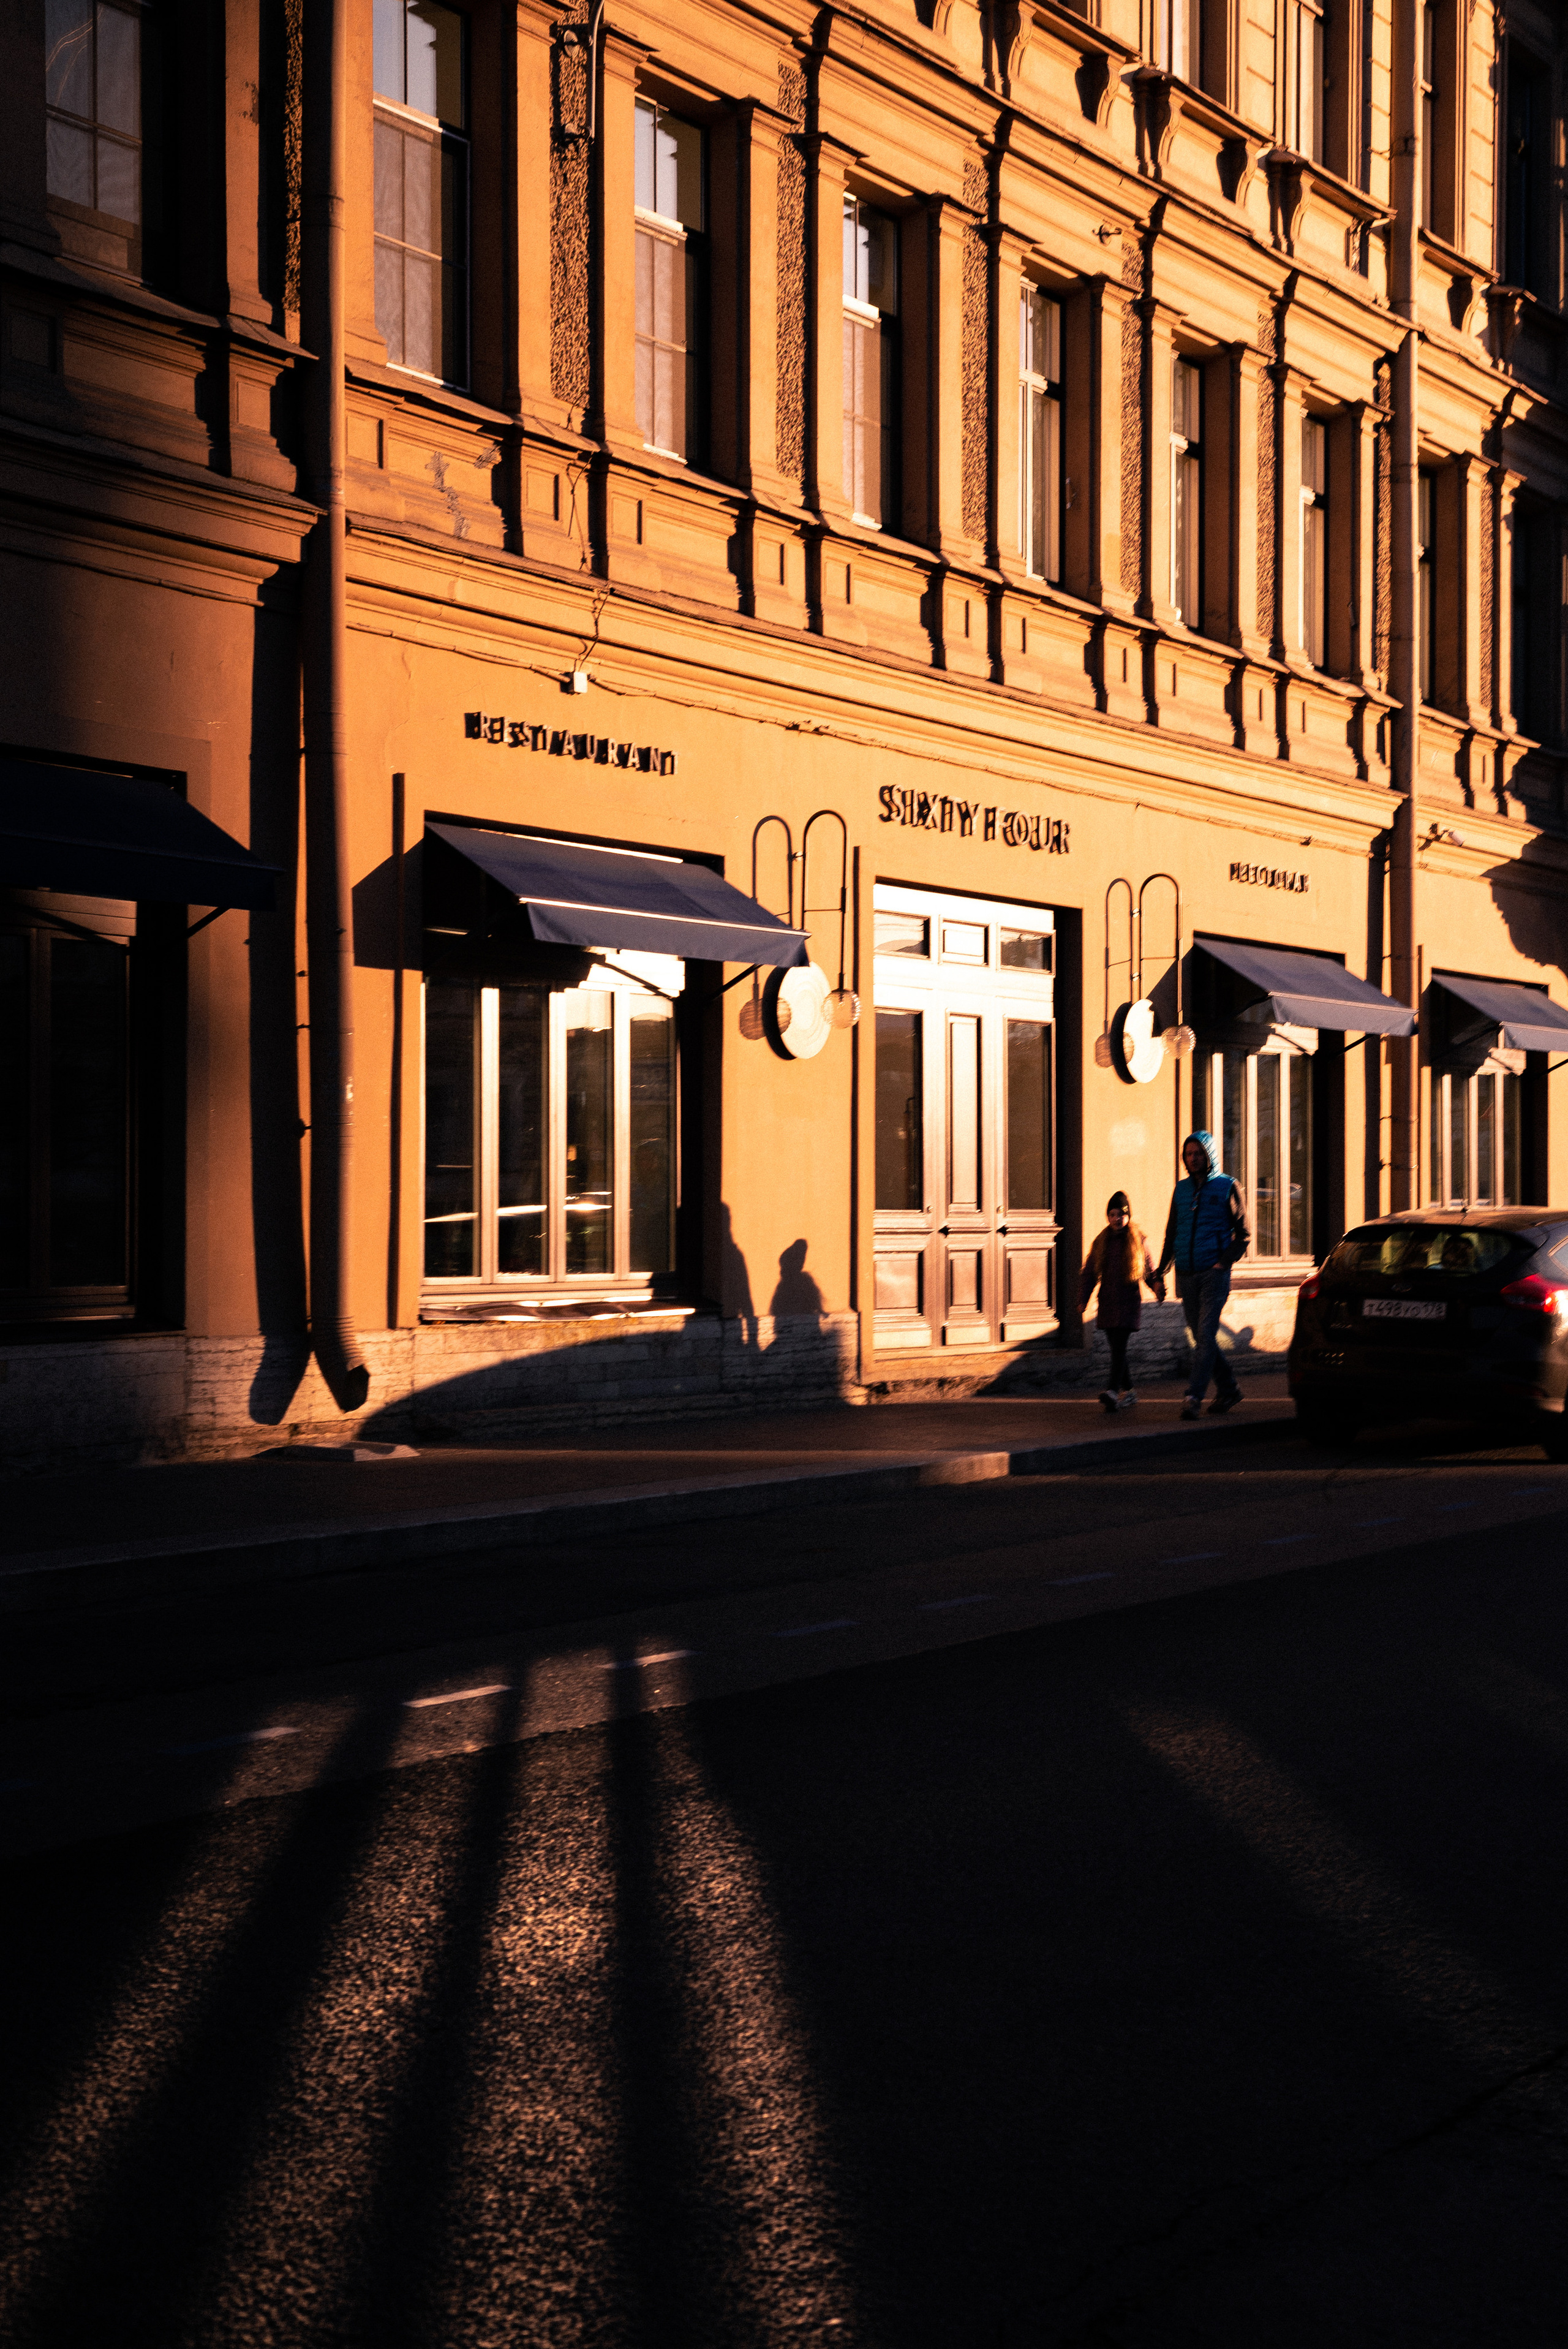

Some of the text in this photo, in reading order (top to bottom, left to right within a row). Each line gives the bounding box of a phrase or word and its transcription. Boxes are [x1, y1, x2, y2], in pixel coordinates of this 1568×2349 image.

[464, 711, 679, 776] RESTAURANT
[879, 784, 1072, 854] SIXTY FOUR
